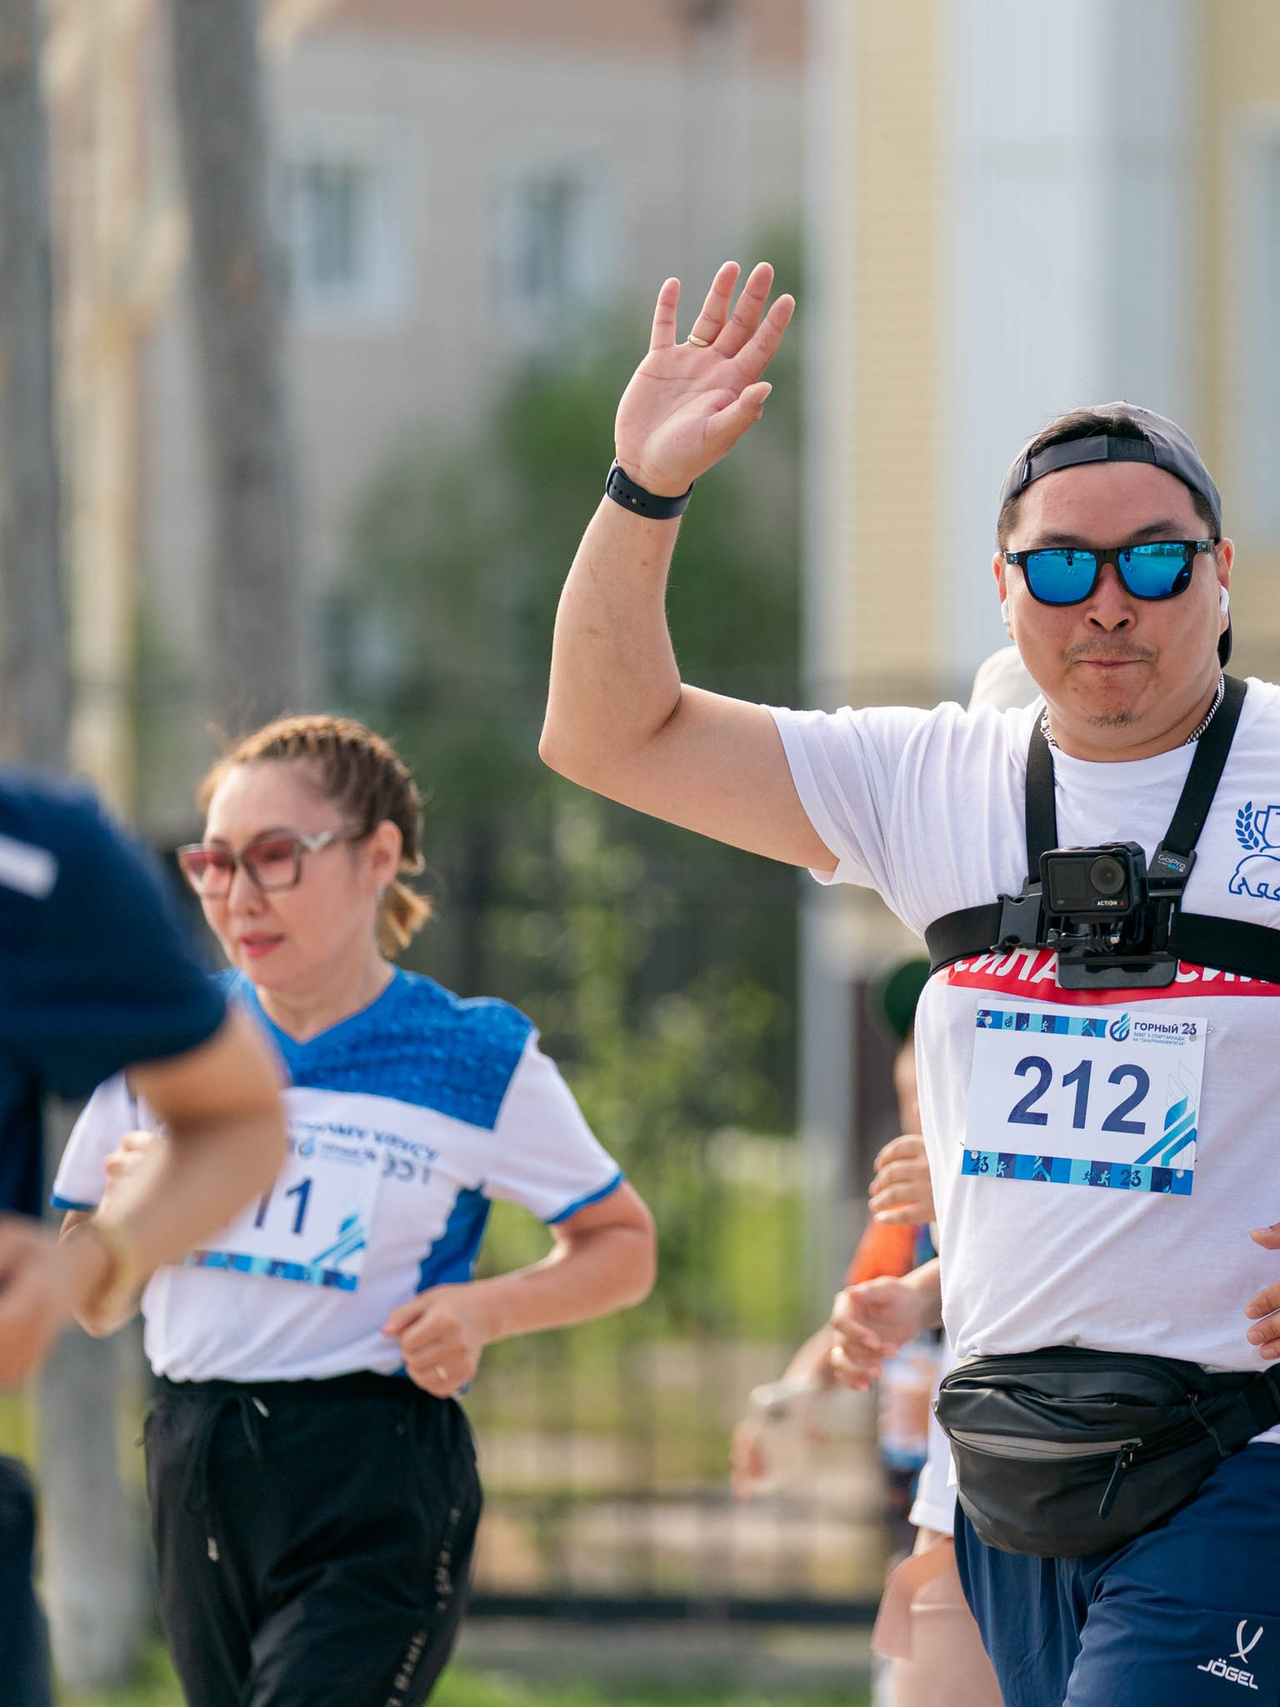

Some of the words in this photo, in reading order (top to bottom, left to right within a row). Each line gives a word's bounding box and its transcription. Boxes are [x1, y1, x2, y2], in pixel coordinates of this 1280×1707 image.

[1158, 854, 1186, 870] GoPro
[1097, 899, 1118, 907] ACTION
[1134, 1022, 1179, 1034] ГОРНЫЙ
[1007, 1055, 1151, 1135] 212
[1120, 1170, 1142, 1187] 23
[1197, 1658, 1258, 1690] JÖGEL
